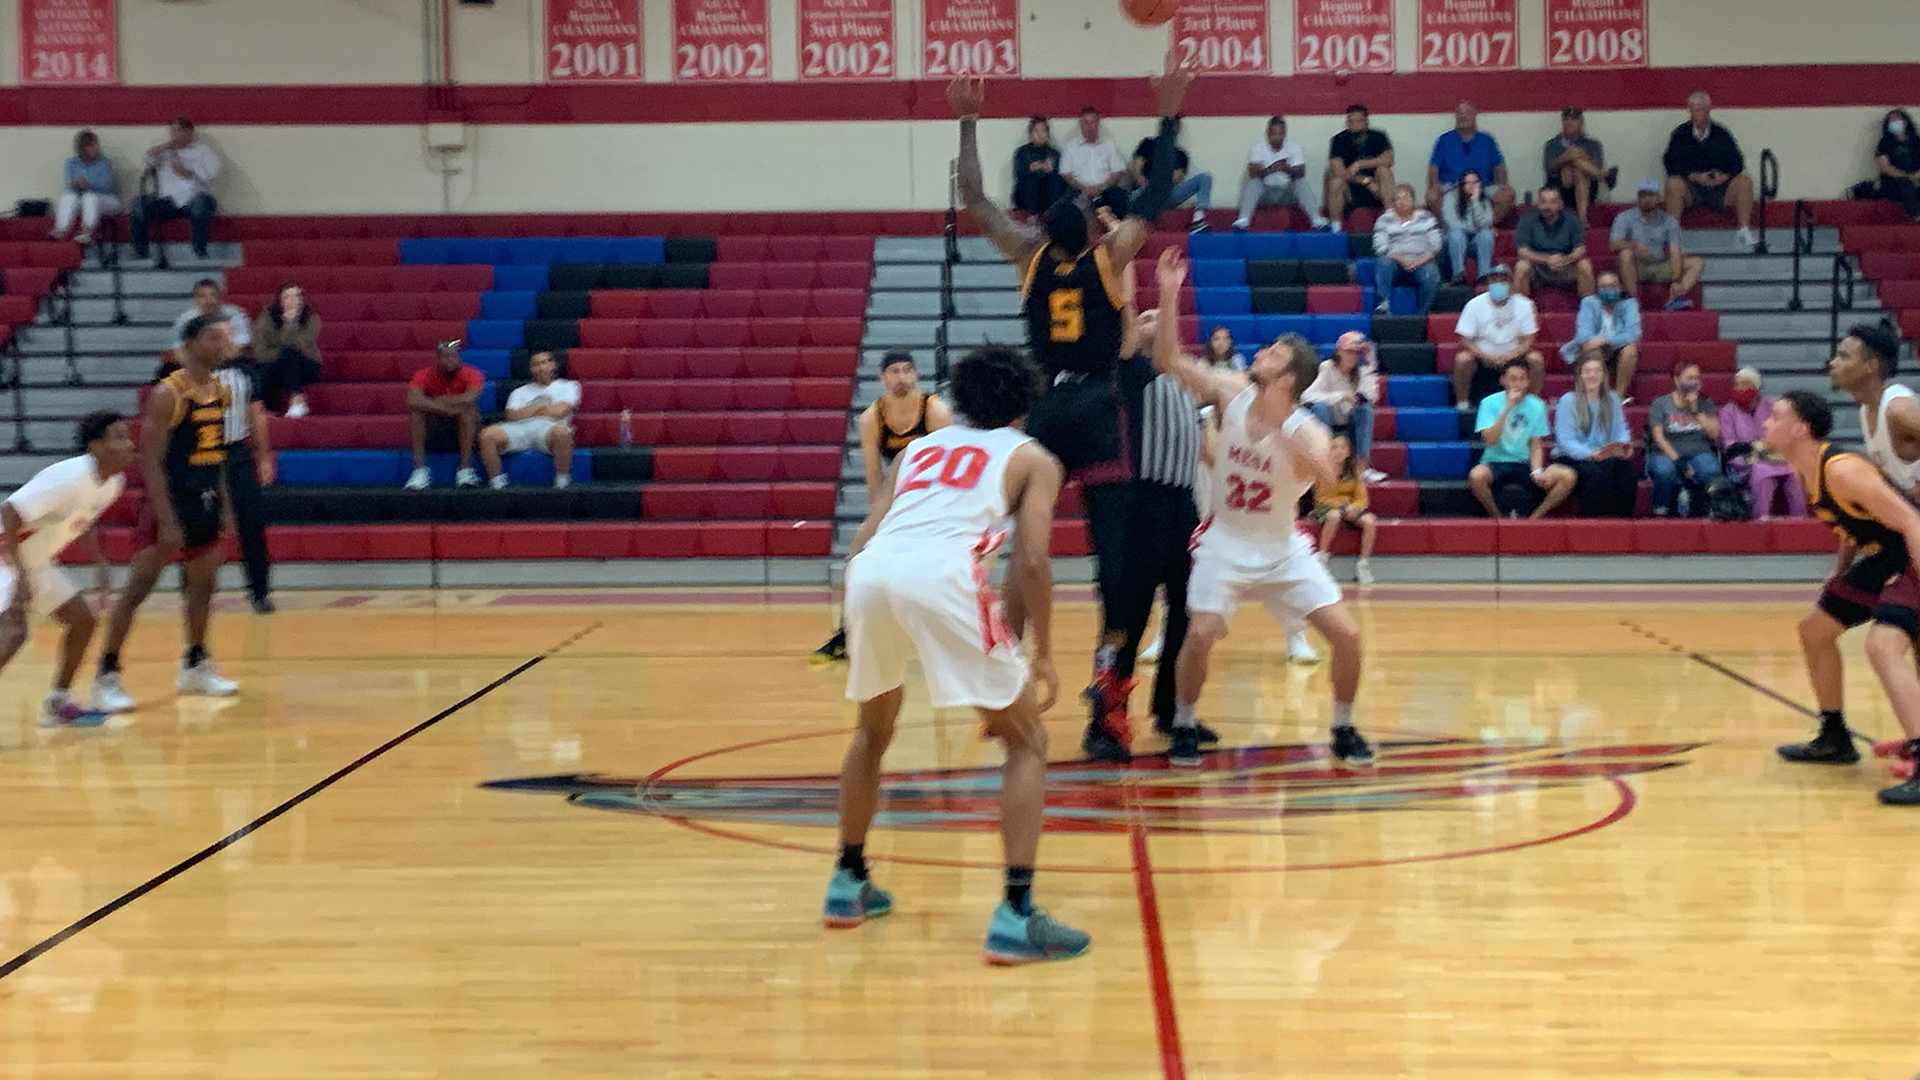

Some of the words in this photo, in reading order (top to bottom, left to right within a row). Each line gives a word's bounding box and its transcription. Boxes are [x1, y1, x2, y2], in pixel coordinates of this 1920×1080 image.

[1426, 11, 1512, 25] CHAMPIONS
[1554, 9, 1640, 23] CHAMPIONS
[551, 41, 637, 76] 2001
[677, 41, 766, 77] 2002
[801, 41, 893, 76] 2002
[926, 38, 1015, 75] 2003
[1178, 34, 1263, 69] 2004
[1300, 33, 1391, 69] 2005
[1422, 31, 1514, 67] 2007
[1551, 27, 1643, 64] 2008
[31, 50, 108, 79] 2014
[1048, 286, 1085, 343] 5
[894, 445, 990, 498] 20
